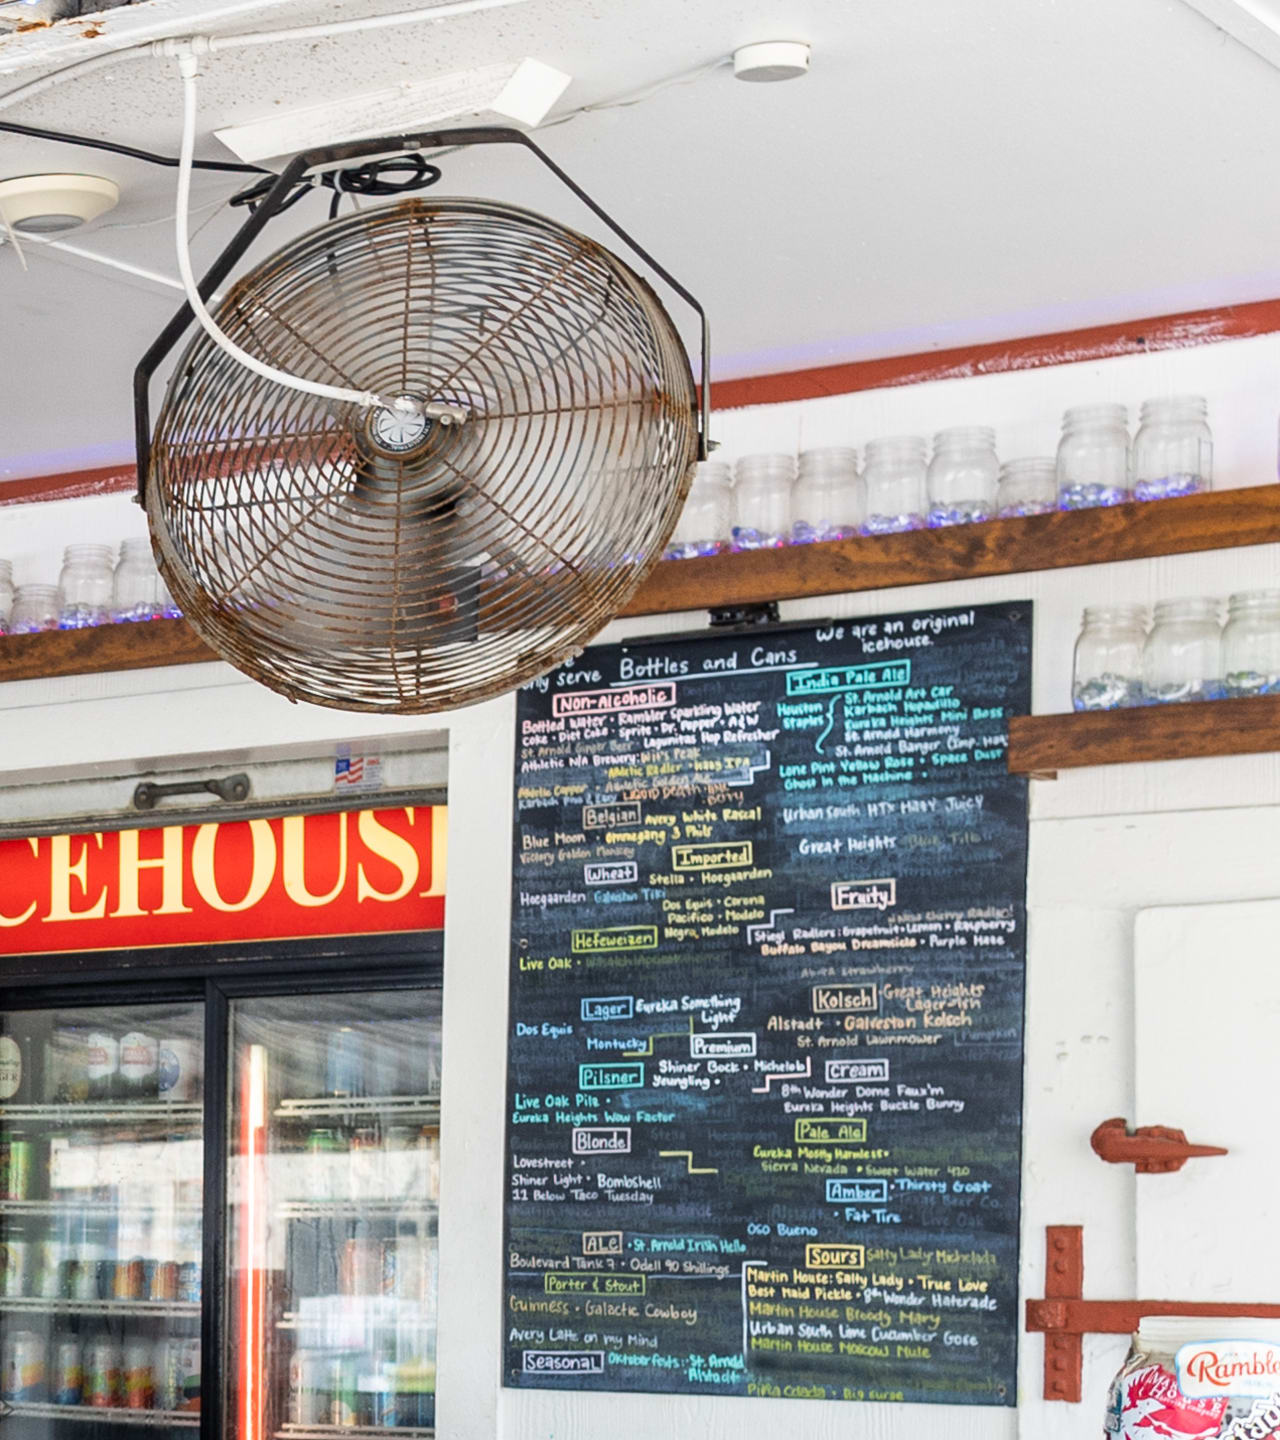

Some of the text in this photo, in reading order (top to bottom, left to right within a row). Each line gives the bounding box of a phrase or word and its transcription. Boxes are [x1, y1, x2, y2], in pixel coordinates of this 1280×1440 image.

[816, 611, 974, 642] We are an original
[557, 647, 804, 686] serve Bottles and Cans
[795, 667, 905, 690] India Pale Ale
[560, 689, 667, 712] Non-Alcoholic
[523, 832, 586, 849] Blue Moon
[799, 836, 896, 854] Great Heights
[680, 847, 748, 865] Imported
[588, 868, 772, 886] Wheat Stella Hoegaarden
[520, 957, 572, 969] Live Oak
[584, 995, 741, 1020] Lager Eureka Something
[701, 1011, 738, 1030] Light
[517, 1023, 573, 1038] Dos Equis
[587, 1038, 647, 1051] Montucky
[694, 1039, 751, 1054] Premium
[584, 1060, 806, 1086] Pilsner Shiner Bock Michelob
[515, 1094, 569, 1110] Live Oak
[577, 1124, 861, 1149] Blonde Pale Ale
[513, 1155, 574, 1169] Lovestreet
[511, 1173, 661, 1189] Shiner Light Bombshell
[831, 1179, 991, 1199] Amber Thirsty Goat
[845, 1208, 901, 1223] Fat Tire
[510, 1253, 730, 1280] Boulevard Tank Odell Shillings
[812, 1249, 858, 1266] Sours
[510, 1296, 697, 1325] Guinness Galactic Cowboy
[509, 1328, 658, 1346] Avery on Mind
